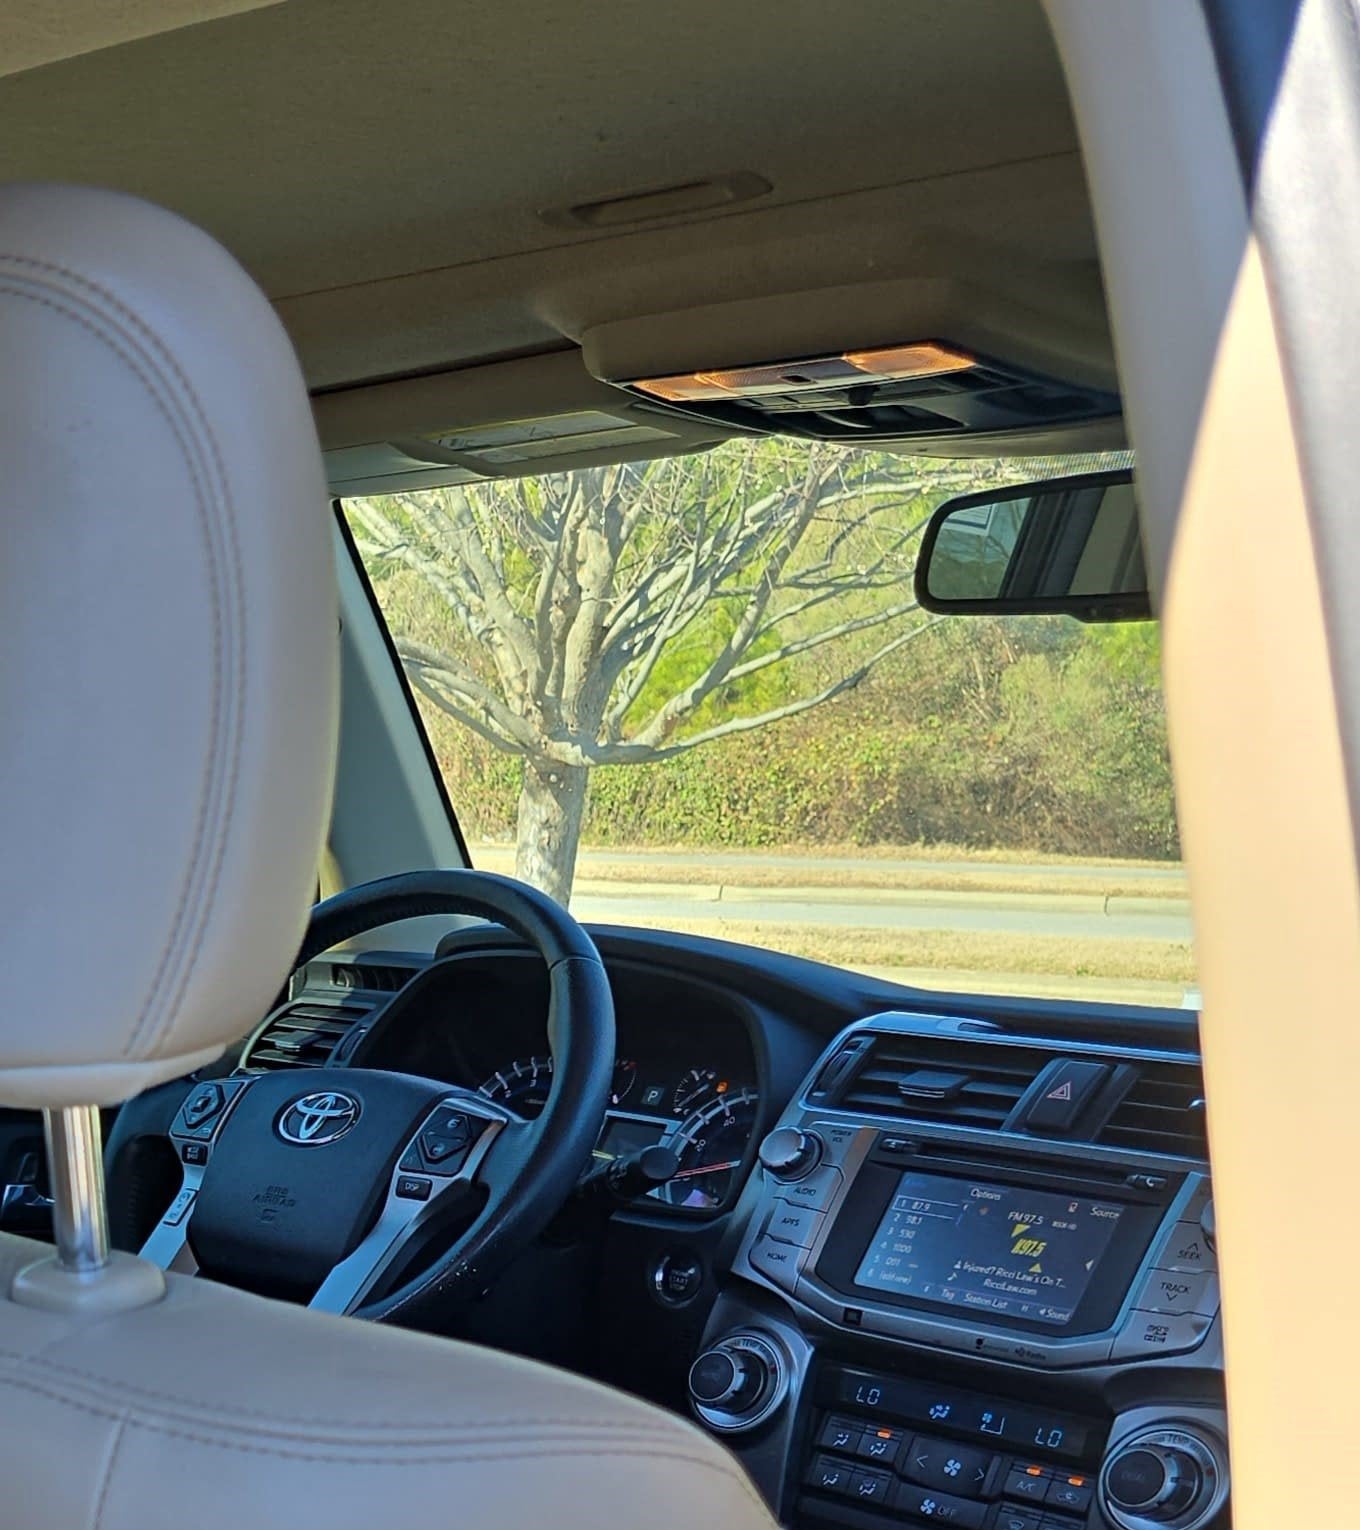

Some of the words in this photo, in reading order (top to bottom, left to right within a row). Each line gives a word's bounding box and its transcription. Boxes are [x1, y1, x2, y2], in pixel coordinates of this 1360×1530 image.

[647, 1090, 658, 1102] P
[970, 1187, 1001, 1201] Options
[1008, 1211, 1024, 1221] FM
[1090, 1206, 1119, 1219] Source
[1178, 1250, 1201, 1260] SEEK
[963, 1261, 995, 1274] Injured?
[995, 1267, 1015, 1279] Ricci
[1016, 1271, 1040, 1283] Law's
[1040, 1275, 1054, 1286] On
[983, 1278, 1037, 1296] RicciLaw.com
[1160, 1281, 1191, 1294] TRACK
[964, 1293, 991, 1305] Station
[991, 1298, 1008, 1310] List
[1046, 1308, 1072, 1321] Sound
[1016, 1480, 1036, 1492] A/C
